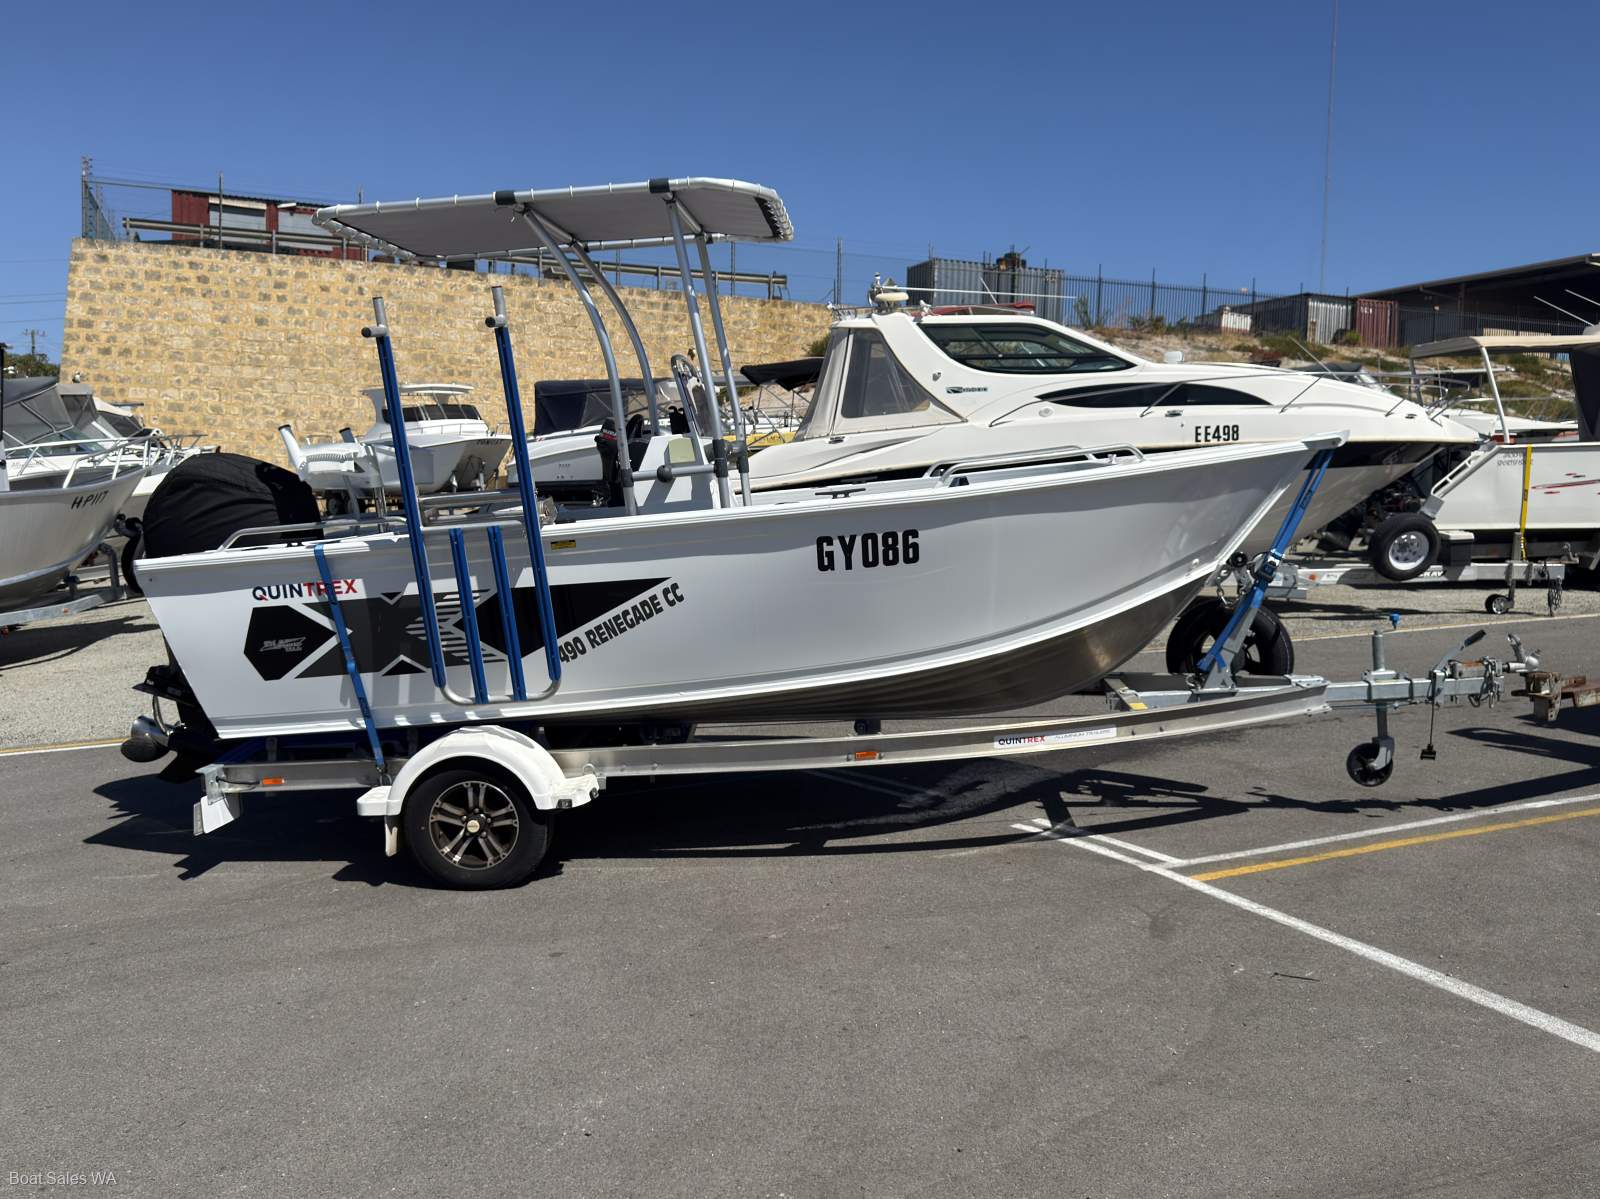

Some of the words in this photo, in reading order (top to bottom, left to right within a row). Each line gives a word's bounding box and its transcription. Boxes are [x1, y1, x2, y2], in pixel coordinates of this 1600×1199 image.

[1194, 424, 1240, 443] EE498
[816, 529, 920, 572] GY086
[558, 636, 587, 663] 490
[584, 593, 664, 649] RENEGADE
[662, 582, 685, 607] CC
[998, 735, 1046, 746] QUINTREX
